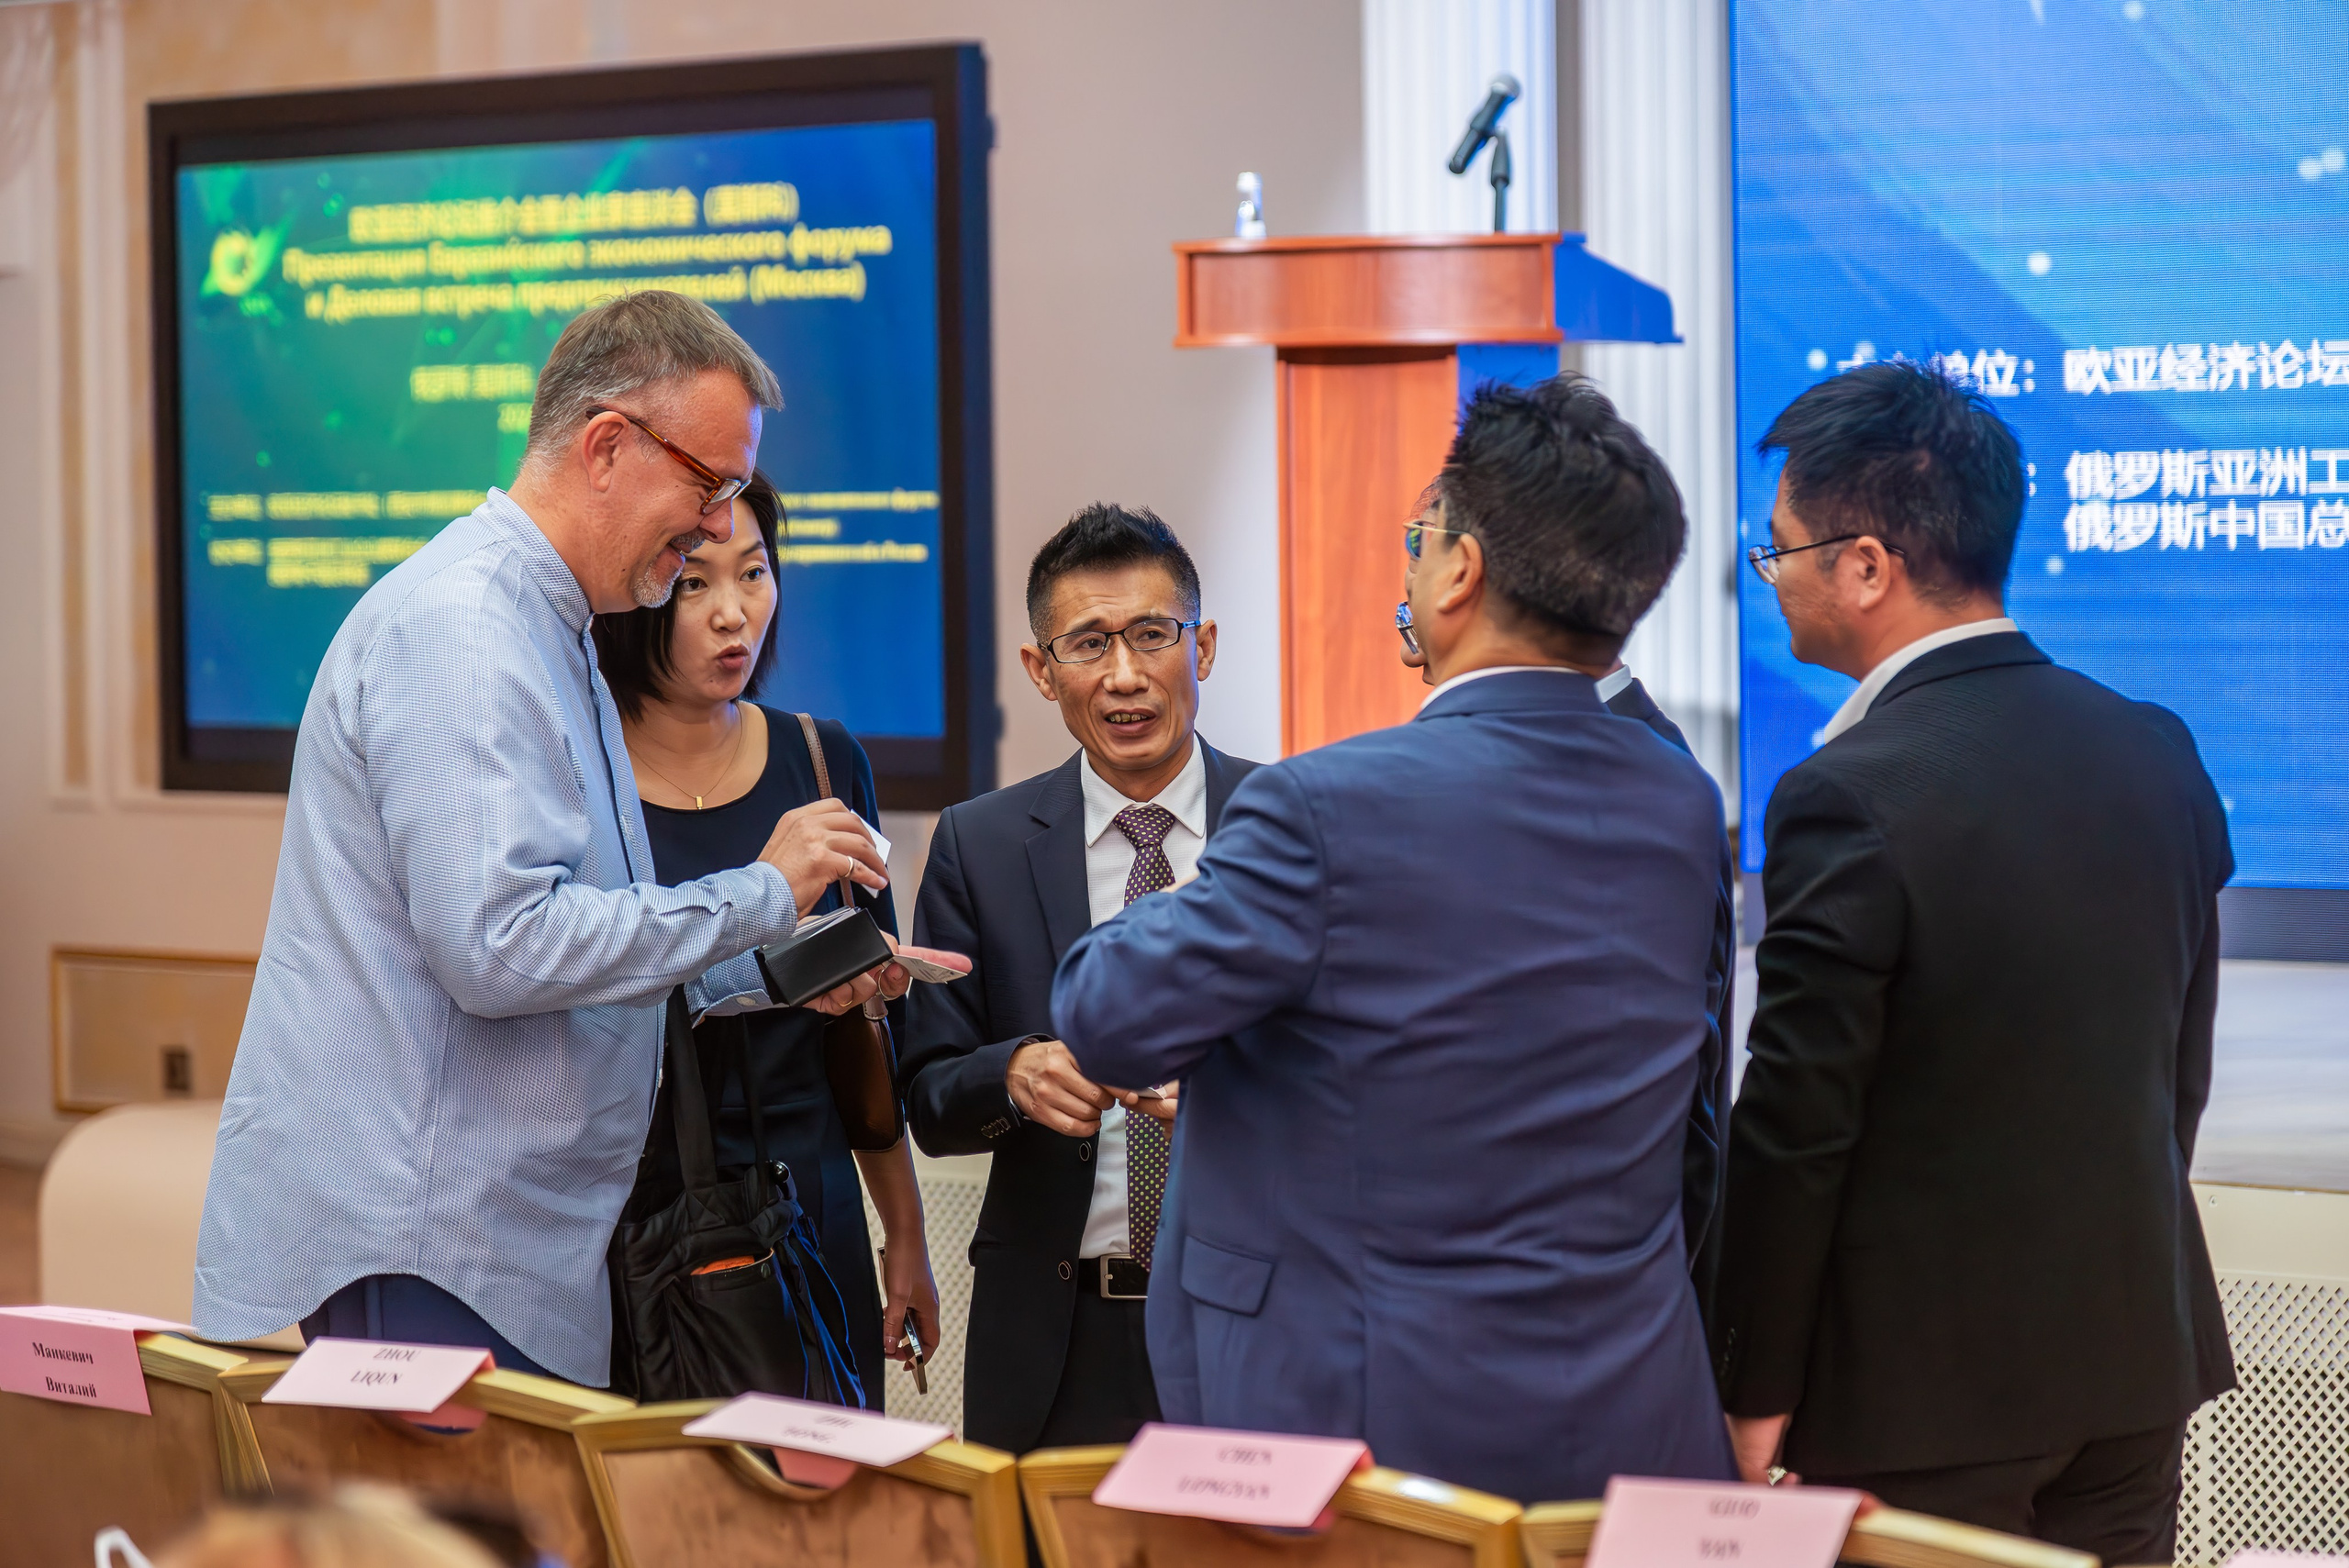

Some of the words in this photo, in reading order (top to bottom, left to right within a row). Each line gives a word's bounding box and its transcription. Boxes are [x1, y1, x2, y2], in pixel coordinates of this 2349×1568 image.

[32, 1341, 94, 1365] Манкевич
[373, 1348, 421, 1362] ZHOU
[45, 1375, 97, 1398] Виталий
[351, 1370, 403, 1387] LIQUN
